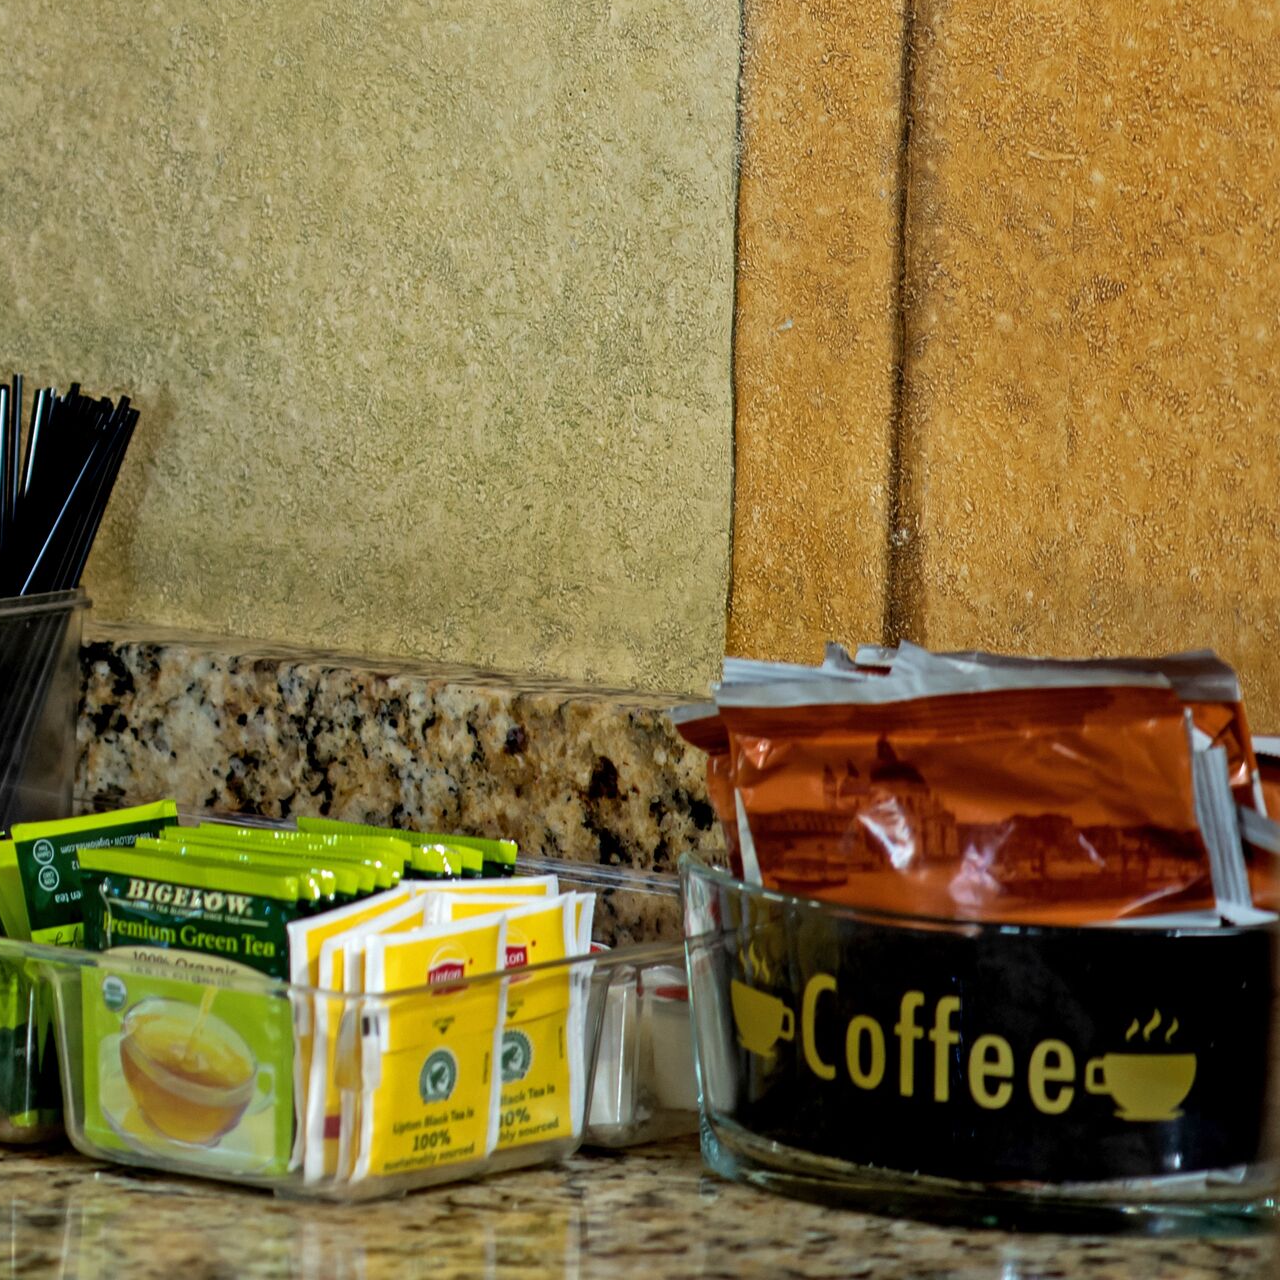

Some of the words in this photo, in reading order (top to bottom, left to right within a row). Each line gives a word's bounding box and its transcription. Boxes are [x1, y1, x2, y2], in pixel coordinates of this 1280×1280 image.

[55, 893, 70, 904] tea
[126, 878, 253, 915] BIGELOW
[180, 925, 238, 953] Green
[241, 933, 275, 957] Tea
[133, 950, 170, 967] 100%
[802, 974, 1076, 1114] Coffee
[527, 1086, 545, 1098] Tea
[393, 1120, 422, 1135] Lipton
[424, 1115, 449, 1128] Black
[451, 1109, 465, 1121] Tea
[518, 1118, 559, 1137] sourced
[412, 1129, 451, 1152] 100%
[383, 1152, 437, 1170] sustainably
[439, 1142, 475, 1159] sourced
